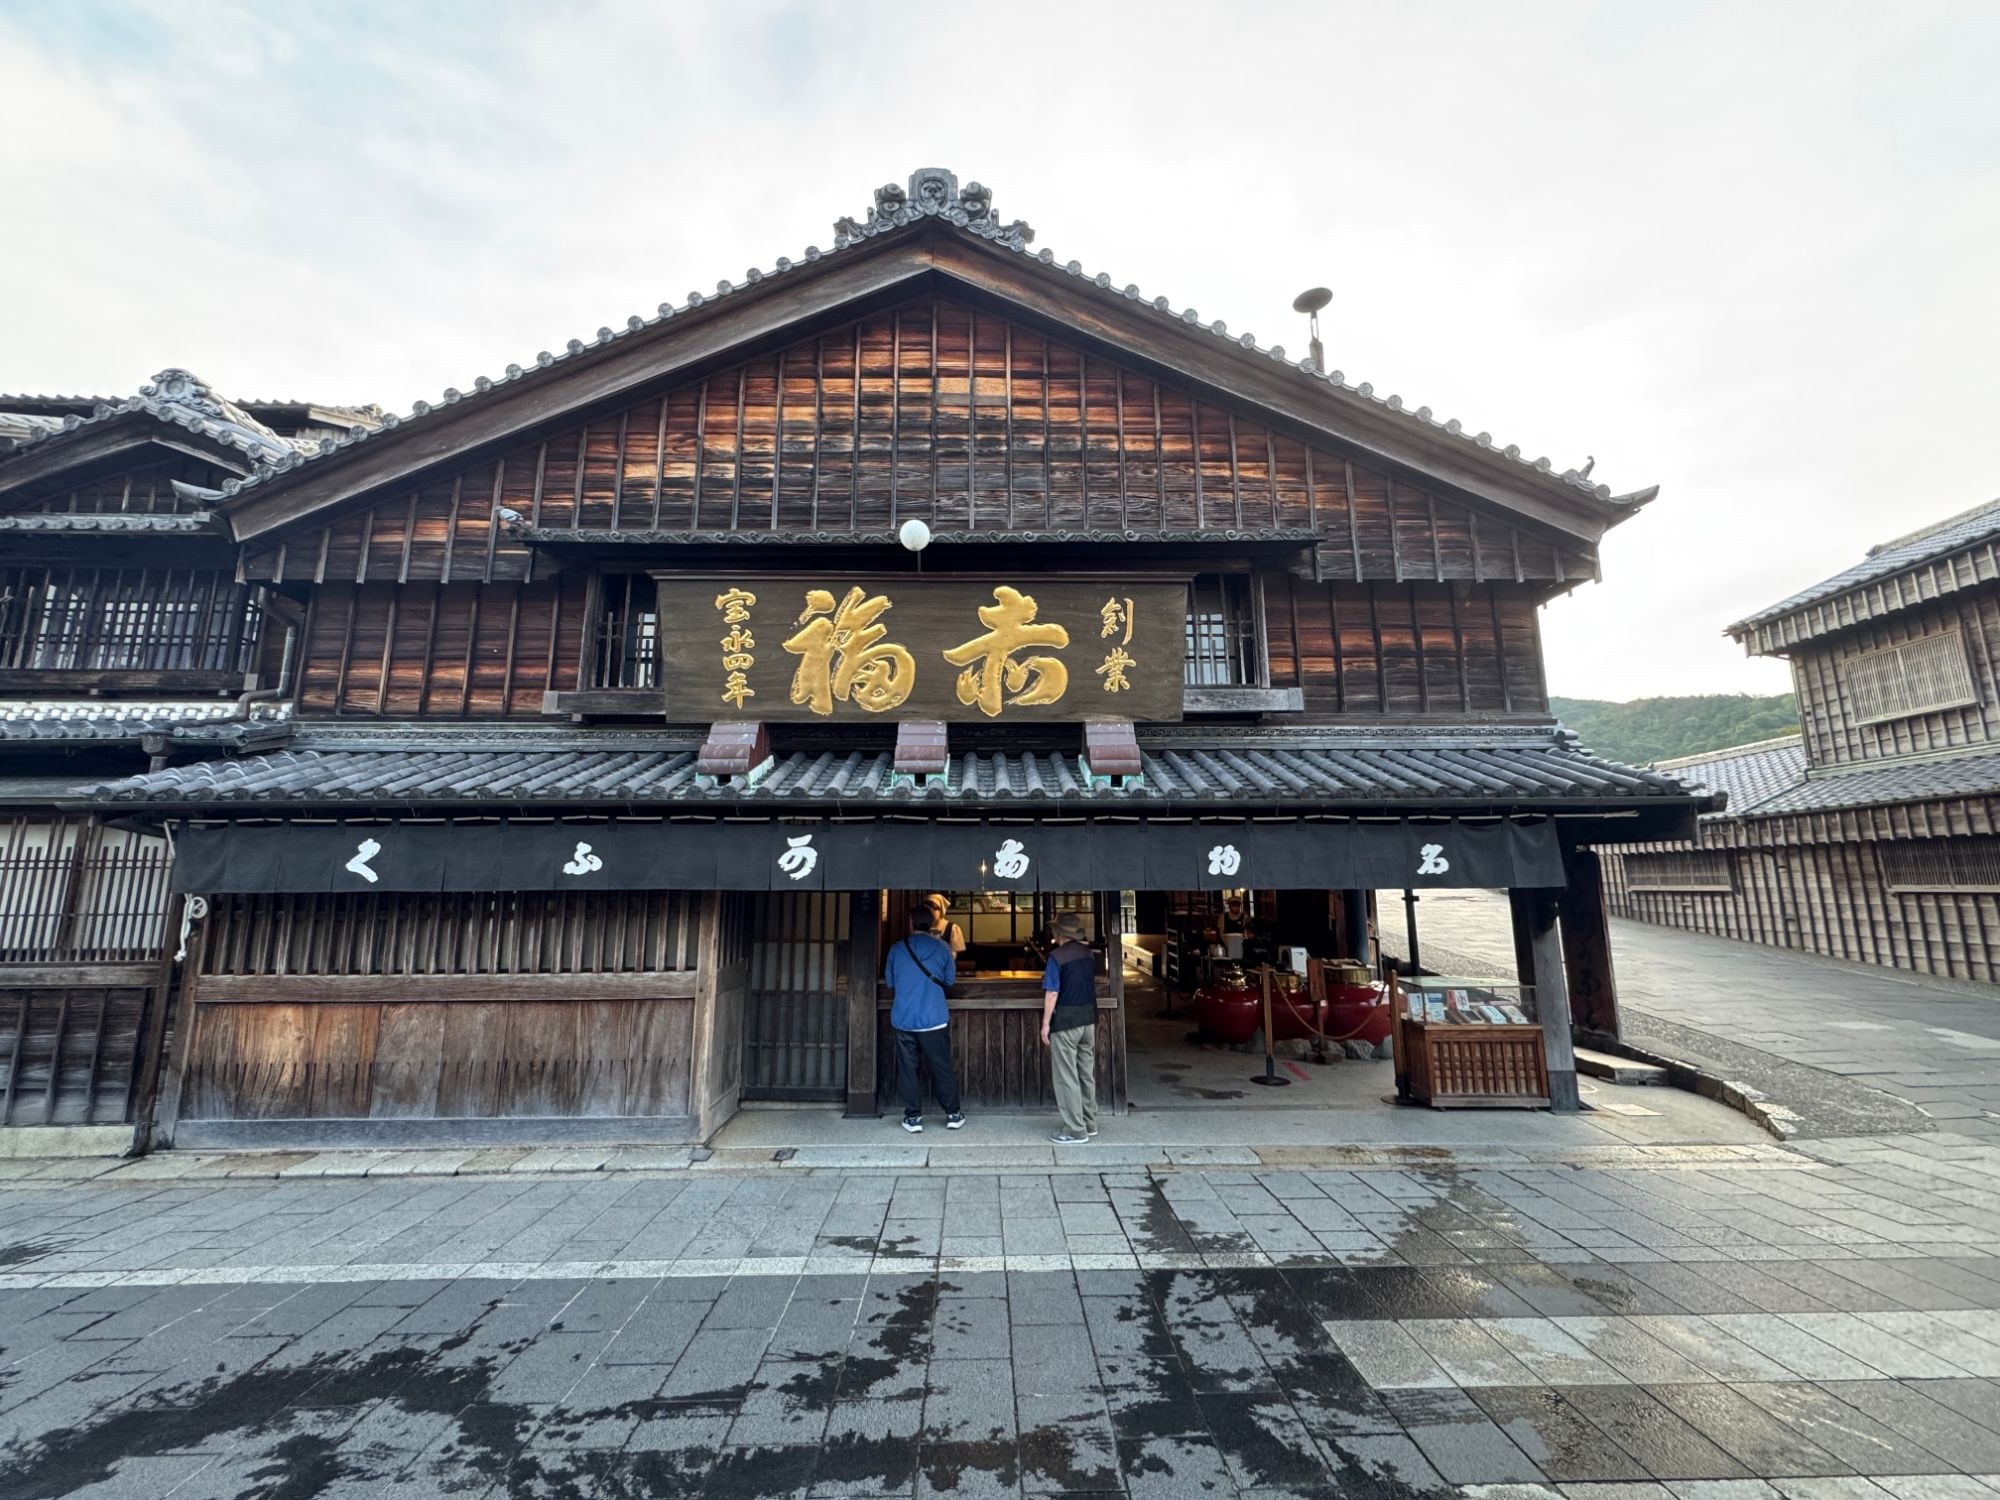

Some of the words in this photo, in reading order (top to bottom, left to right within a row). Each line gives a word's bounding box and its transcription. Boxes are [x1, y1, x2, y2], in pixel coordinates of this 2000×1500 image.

[714, 587, 758, 710] 宝永四年
[782, 586, 1071, 717] 赤福
